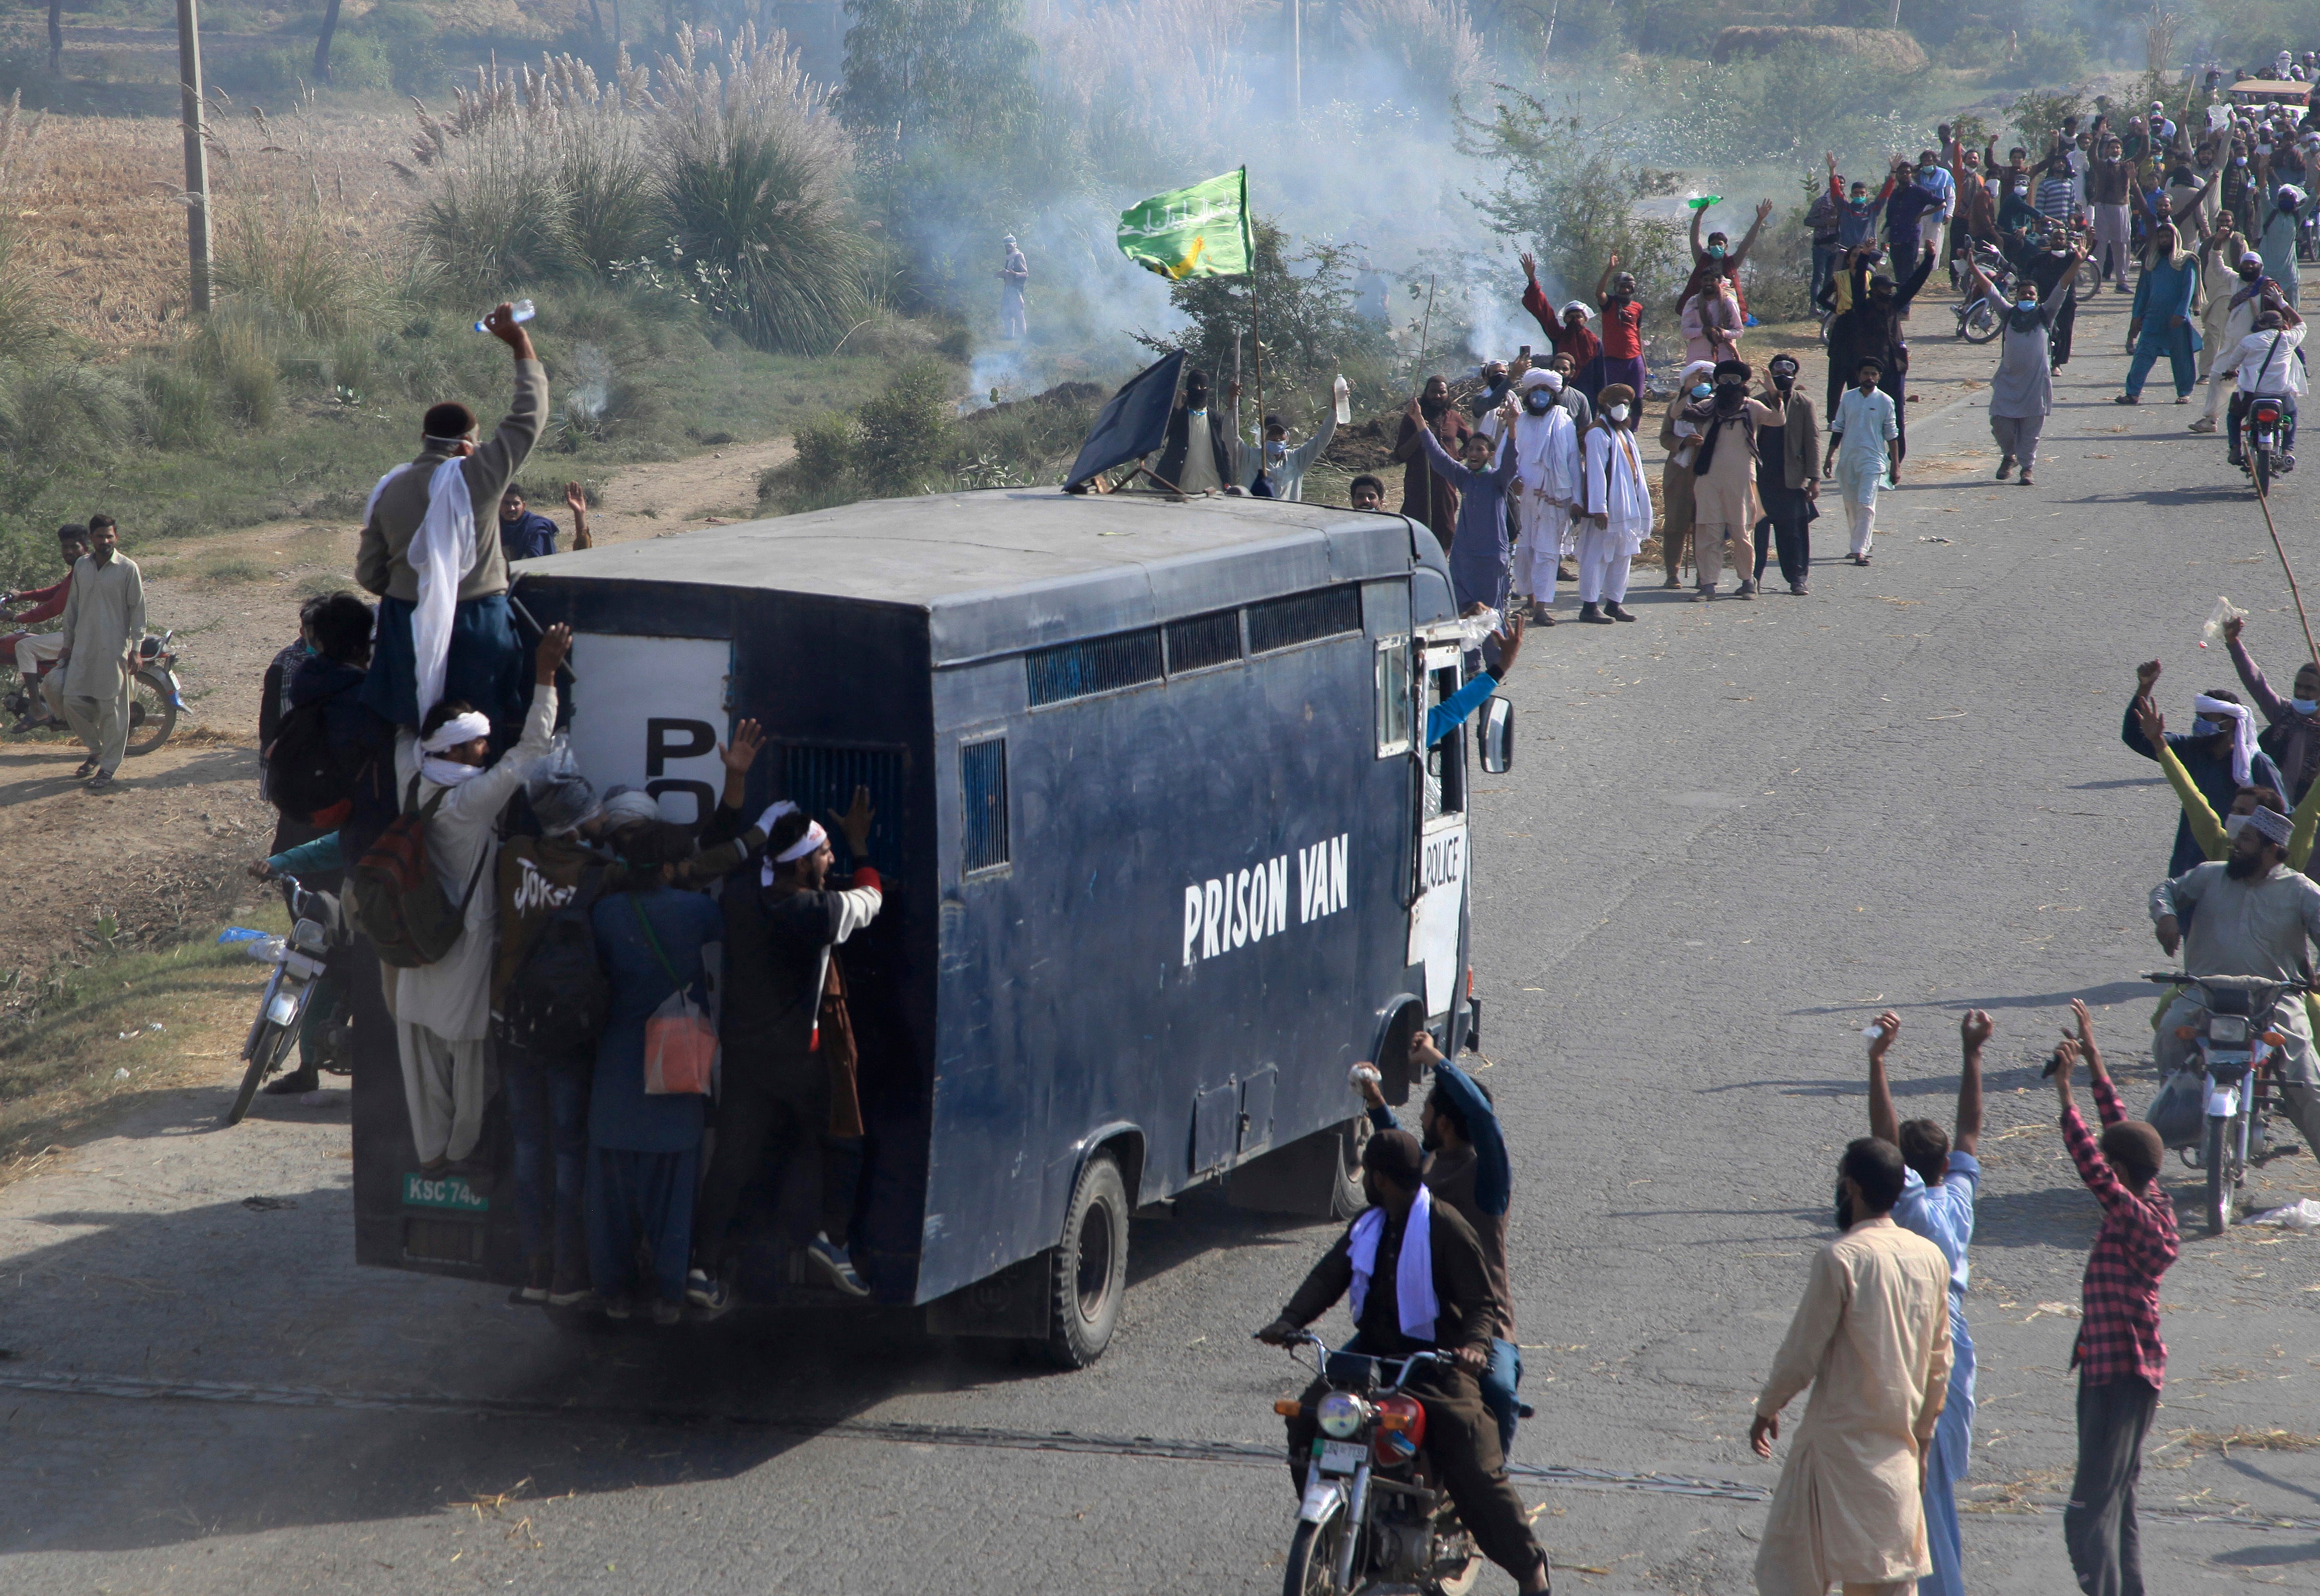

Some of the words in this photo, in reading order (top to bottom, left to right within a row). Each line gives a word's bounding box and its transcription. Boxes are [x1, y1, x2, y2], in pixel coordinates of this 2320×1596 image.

[1427, 835, 1459, 895] POLICE
[1184, 854, 1287, 967] PRISON
[1299, 833, 1348, 924] VAN
[410, 1178, 446, 1202] KSC
